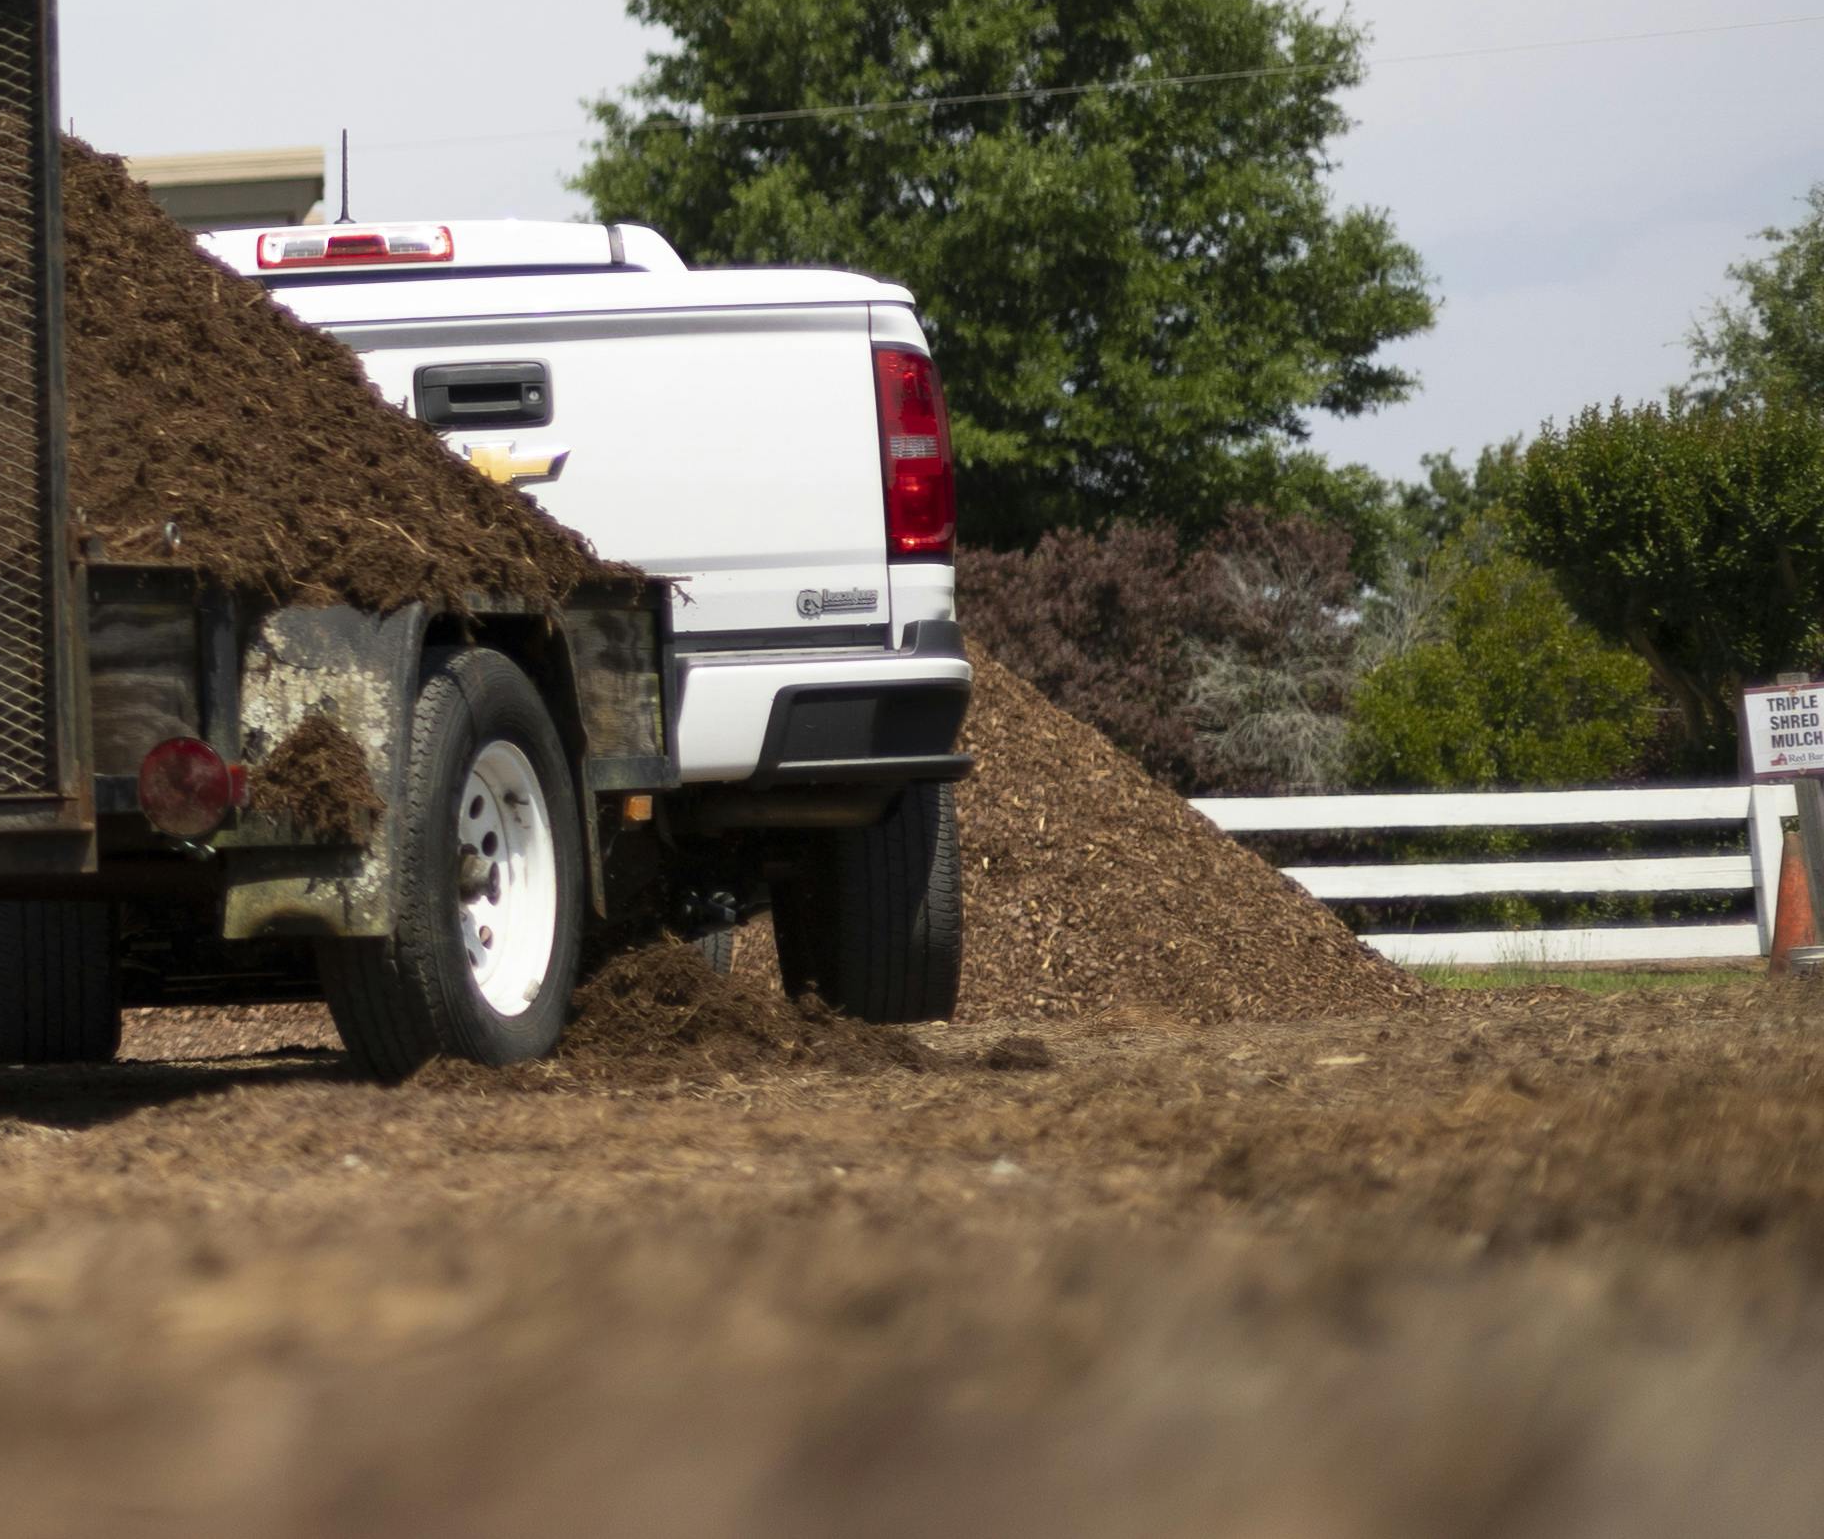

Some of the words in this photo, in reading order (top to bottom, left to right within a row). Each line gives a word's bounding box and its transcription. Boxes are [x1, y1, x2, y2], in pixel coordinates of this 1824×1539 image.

[1766, 695, 1818, 712] TRIPLE
[1770, 713, 1819, 730] SHRED
[1771, 731, 1824, 749] MULCH
